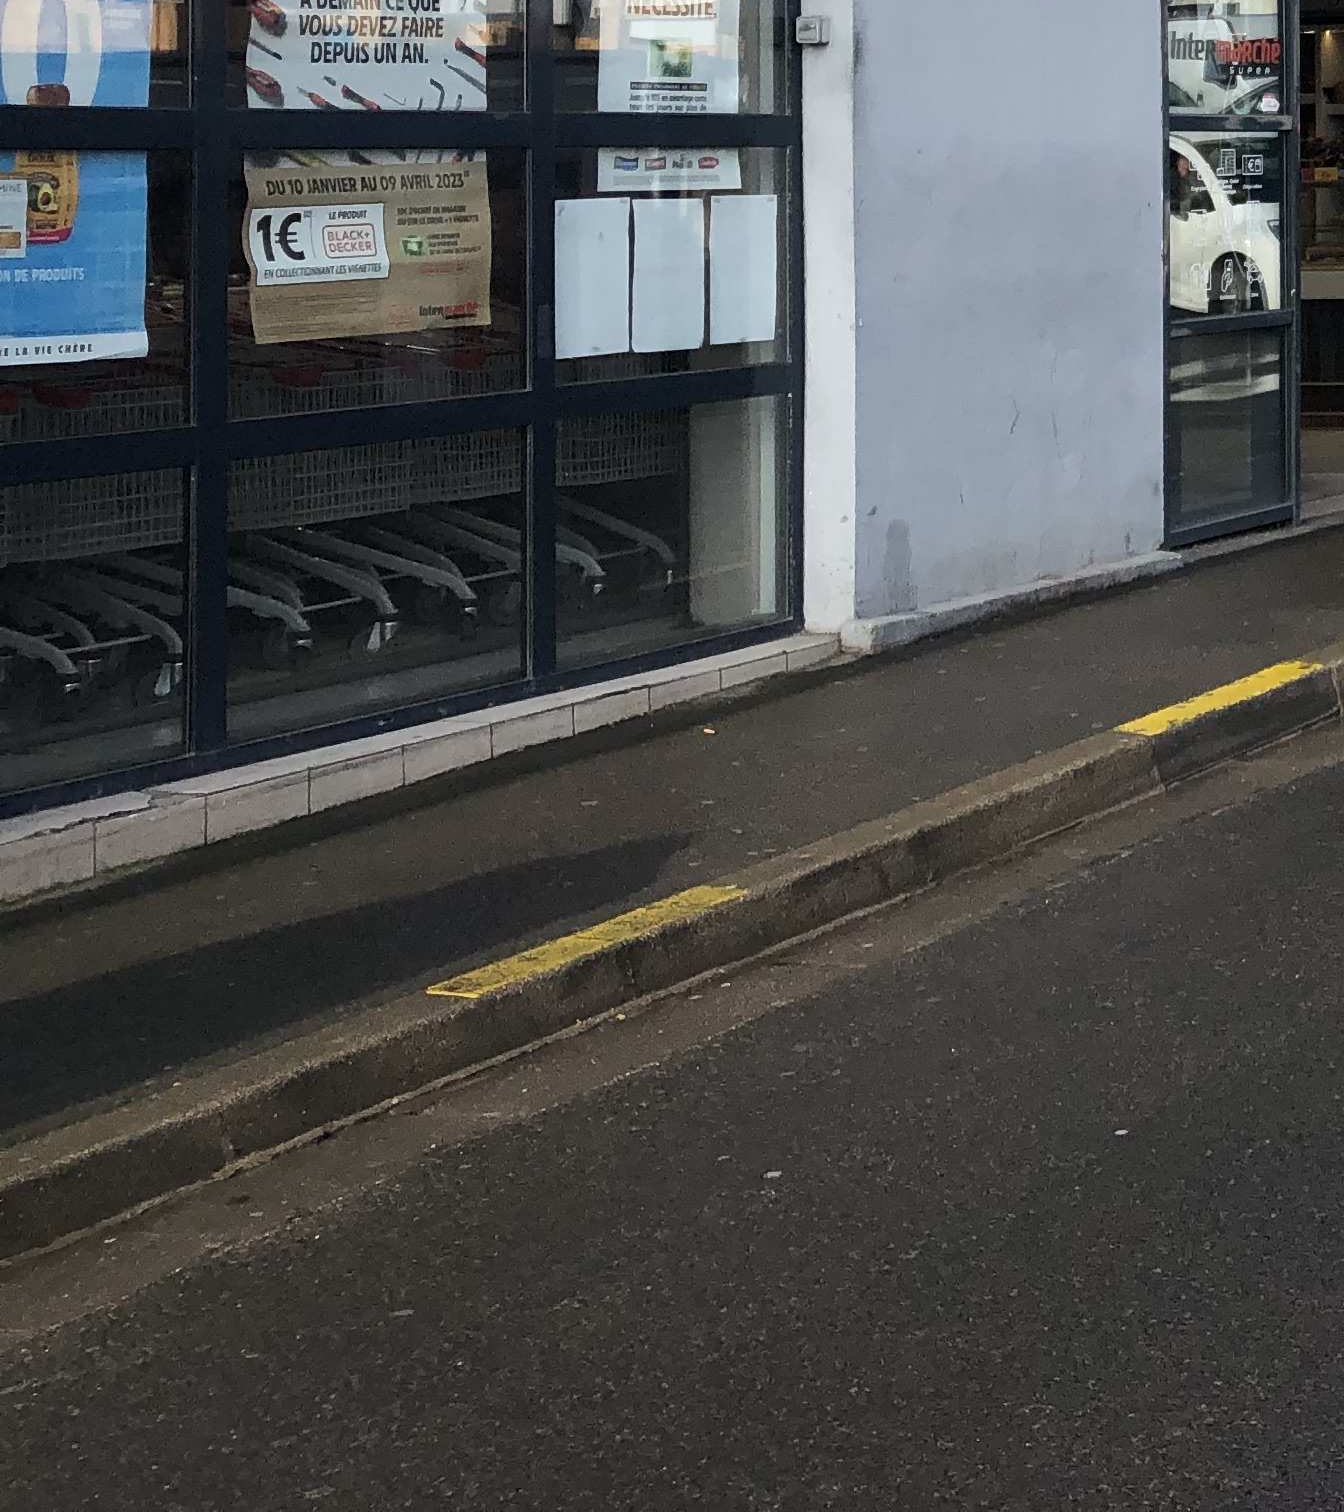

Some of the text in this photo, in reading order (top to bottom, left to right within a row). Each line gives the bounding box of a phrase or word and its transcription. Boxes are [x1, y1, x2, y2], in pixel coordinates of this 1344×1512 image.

[299, 14, 445, 38] VOUS DEVEZ FAIRE
[310, 41, 429, 64] DEPUIS UN AN.
[1229, 66, 1271, 76] SUPER
[266, 180, 286, 196] DU
[288, 179, 303, 195] 10
[307, 177, 358, 194] JANVIER
[360, 175, 377, 192] AU
[380, 176, 397, 192] 09
[400, 173, 433, 191] AVRIL
[328, 210, 367, 220] LE PRODUIT
[328, 241, 372, 253] DECKER
